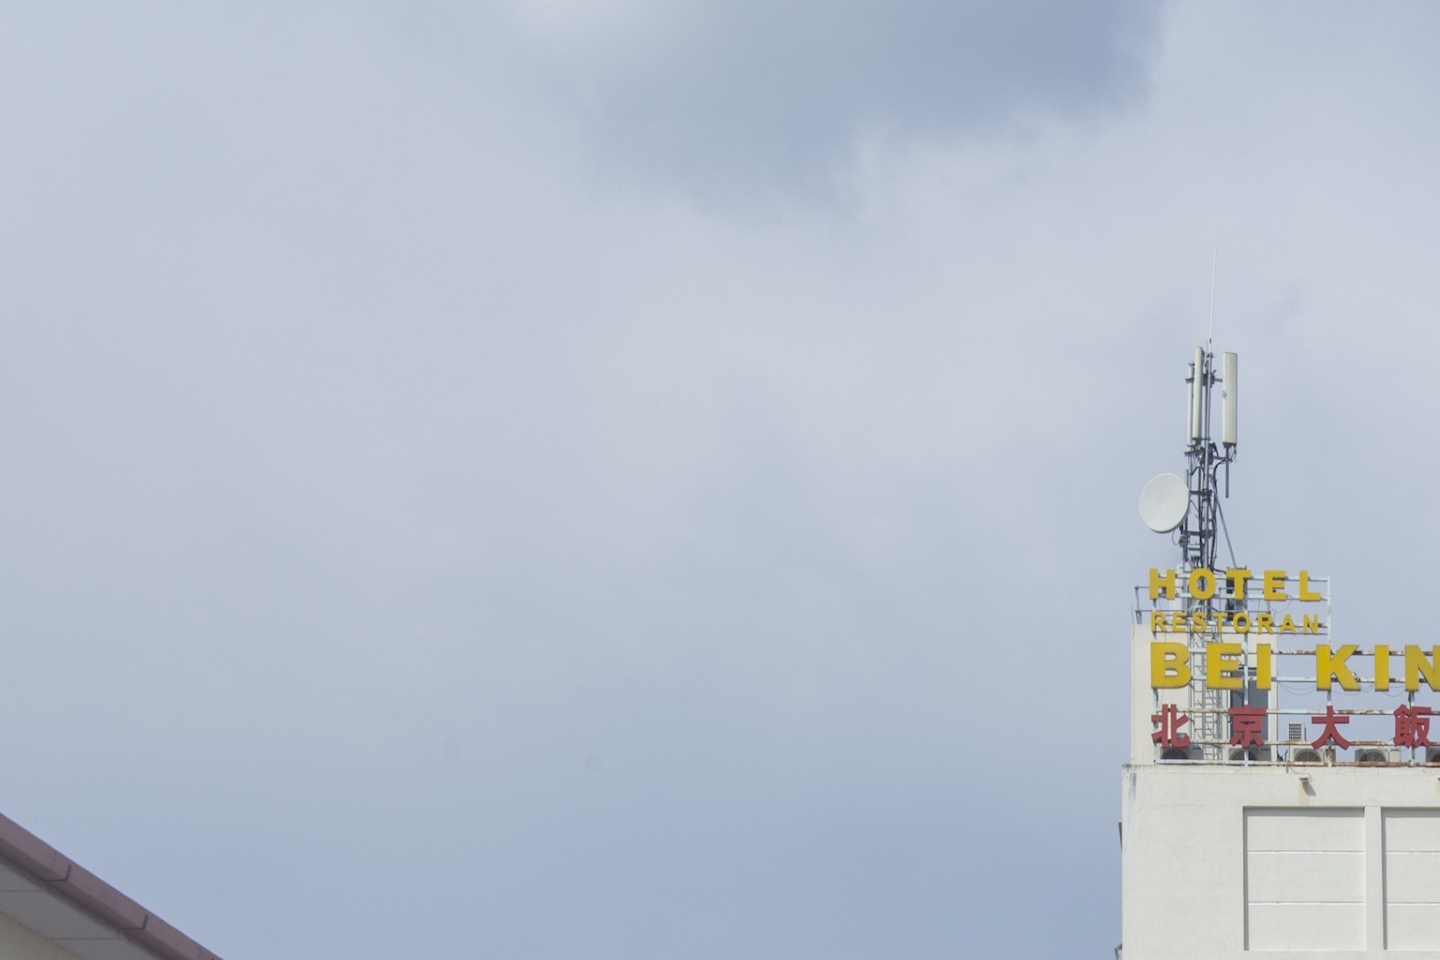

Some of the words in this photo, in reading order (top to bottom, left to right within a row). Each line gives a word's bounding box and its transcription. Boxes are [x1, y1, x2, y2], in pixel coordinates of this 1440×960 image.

[1149, 568, 1321, 602] HOTEL
[1151, 611, 1319, 635] RESTORAN
[1150, 642, 1271, 690] BEI
